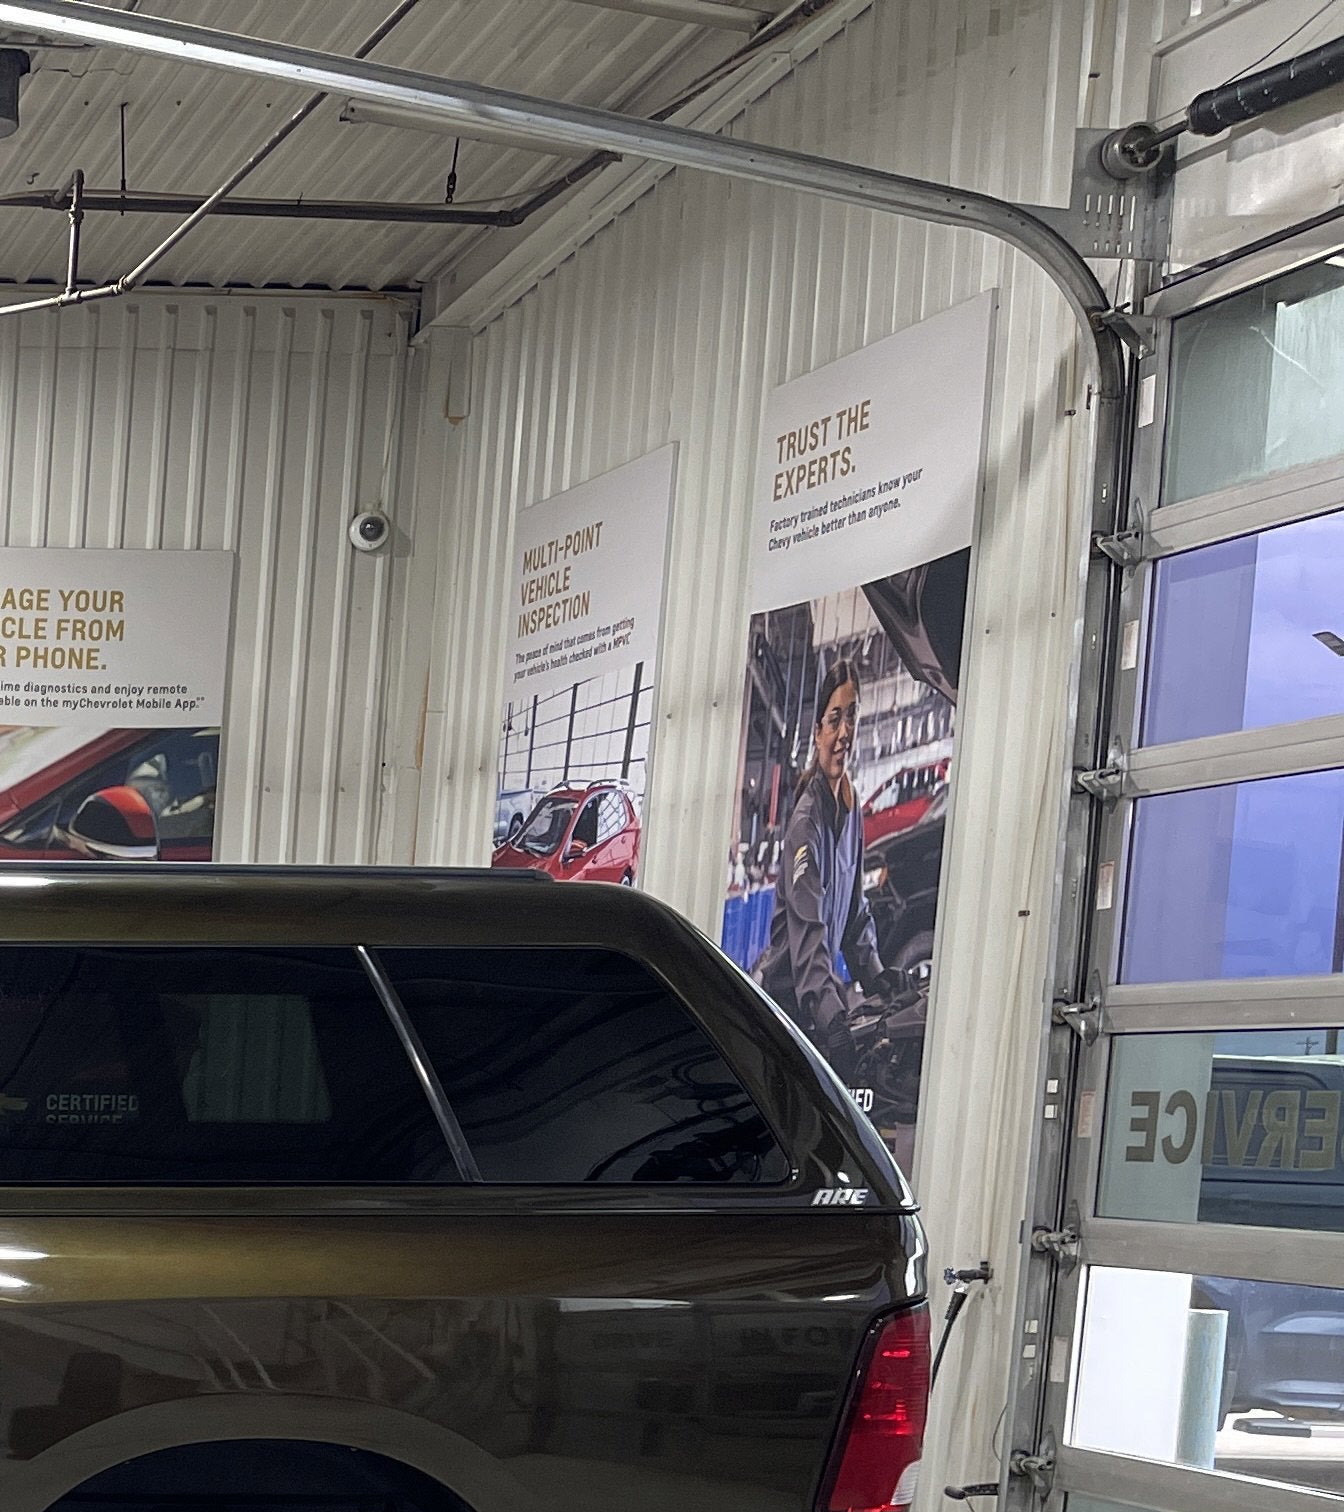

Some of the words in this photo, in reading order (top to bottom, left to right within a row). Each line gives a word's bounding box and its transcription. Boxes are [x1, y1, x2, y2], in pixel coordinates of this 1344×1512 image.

[776, 415, 832, 464] TRUST
[836, 399, 871, 441] THE
[773, 446, 856, 502] EXPERTS.
[769, 512, 799, 533] Factory
[800, 500, 828, 523] trained
[829, 485, 876, 513] technicians
[878, 475, 901, 496] know
[902, 468, 924, 490] your
[768, 534, 792, 551] Chevy
[792, 523, 820, 545] vehicle
[820, 516, 847, 536] better
[847, 509, 866, 526] than
[868, 496, 901, 519] anyone.
[522, 521, 604, 576] MULTI-POINT
[59, 589, 125, 613] YOUR
[520, 566, 572, 607] VEHICLE
[56, 618, 125, 642] FROM
[517, 590, 591, 639] INSPECTION
[15, 646, 107, 671] PHONE.
[23, 681, 88, 696] diagnostics
[91, 683, 111, 694] and
[114, 683, 144, 697] enjoy
[147, 684, 188, 694] remote
[24, 698, 37, 707] on
[41, 697, 59, 708] the
[62, 698, 133, 710] myChevrolet
[136, 698, 172, 709] Mobile
[45, 1093, 140, 1112] CERTIFIED
